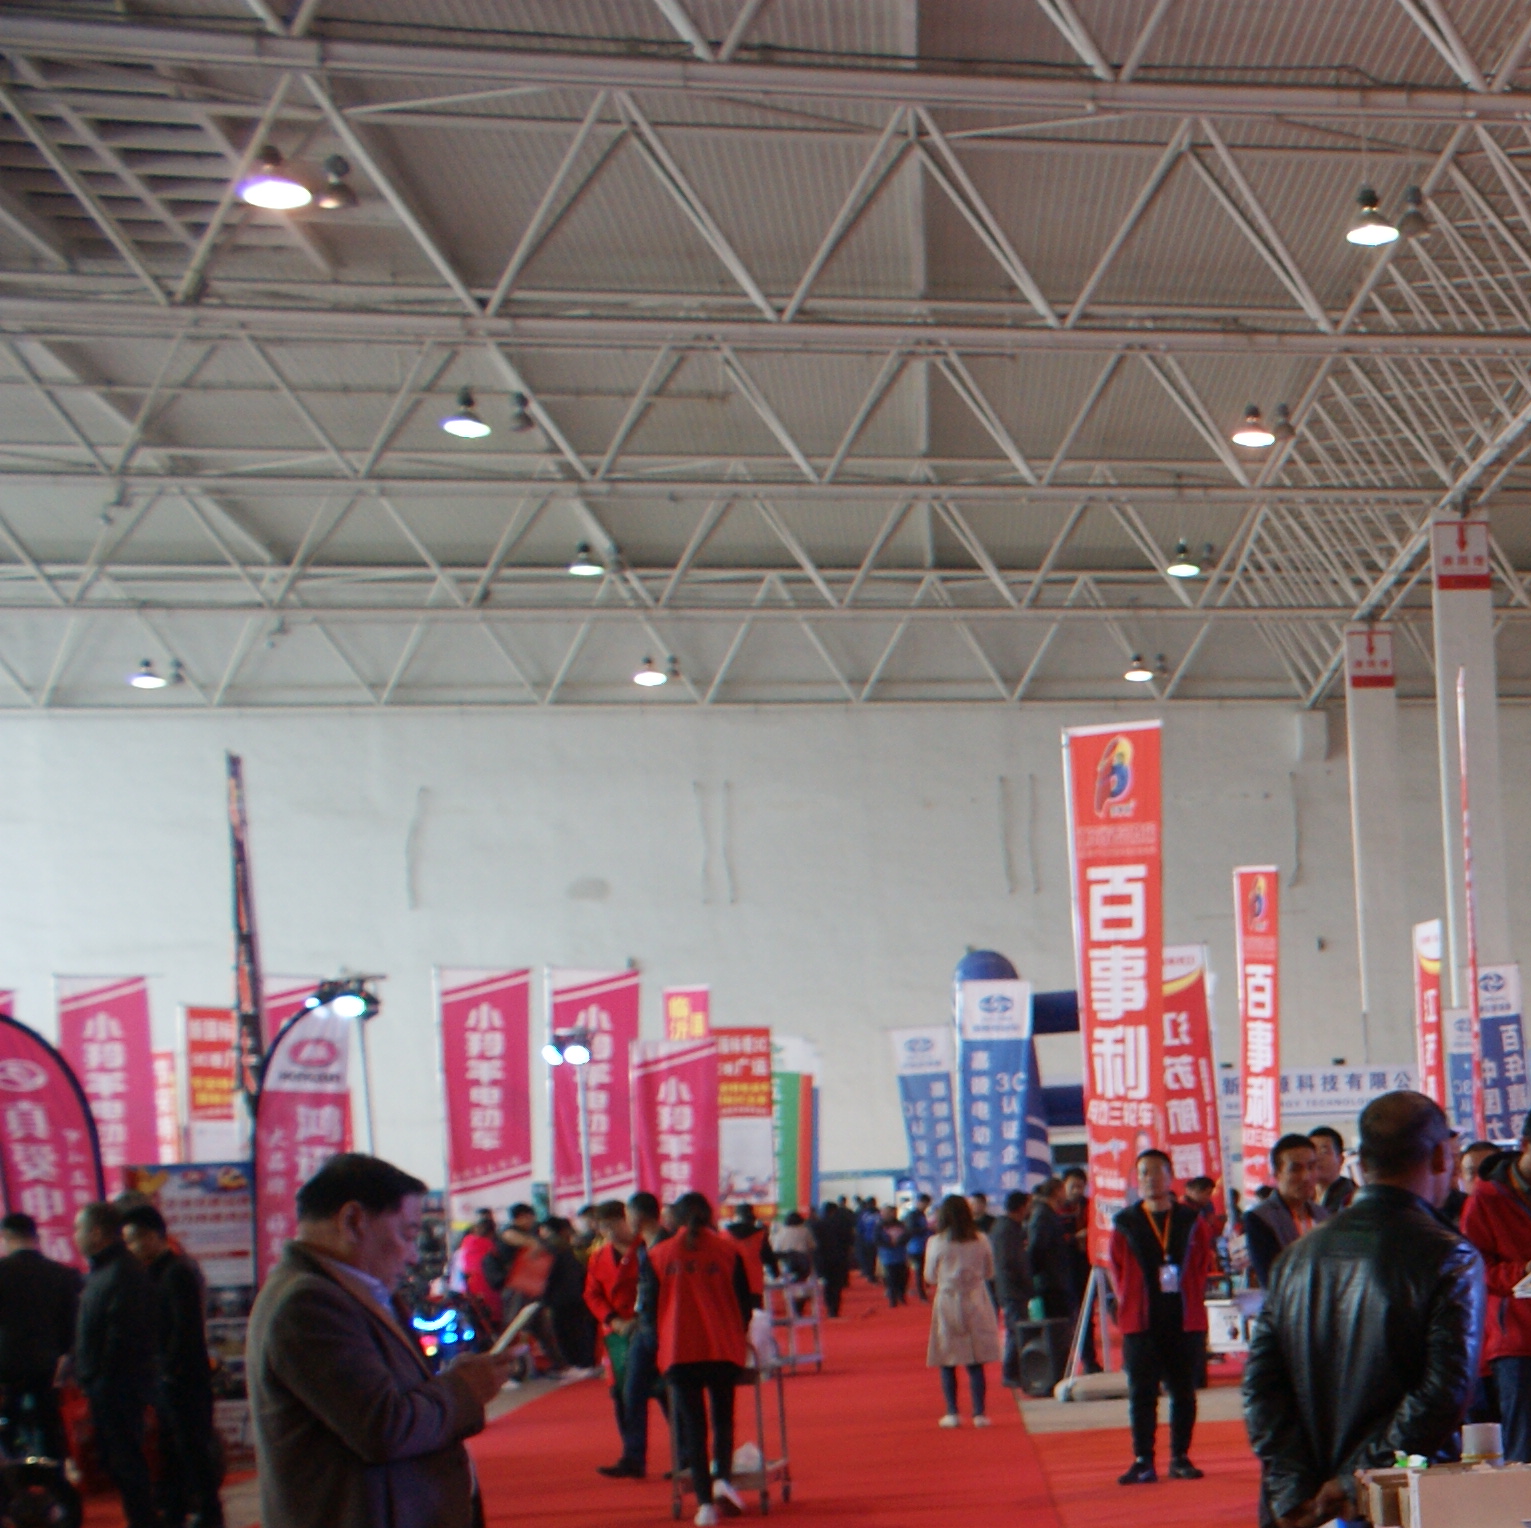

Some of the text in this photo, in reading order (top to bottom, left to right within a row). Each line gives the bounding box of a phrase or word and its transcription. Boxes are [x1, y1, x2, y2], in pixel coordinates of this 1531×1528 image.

[1086, 864, 1150, 1100] 百事利
[1245, 963, 1275, 1129] 百事利
[1222, 1070, 1412, 1096] 新源科技有限公
